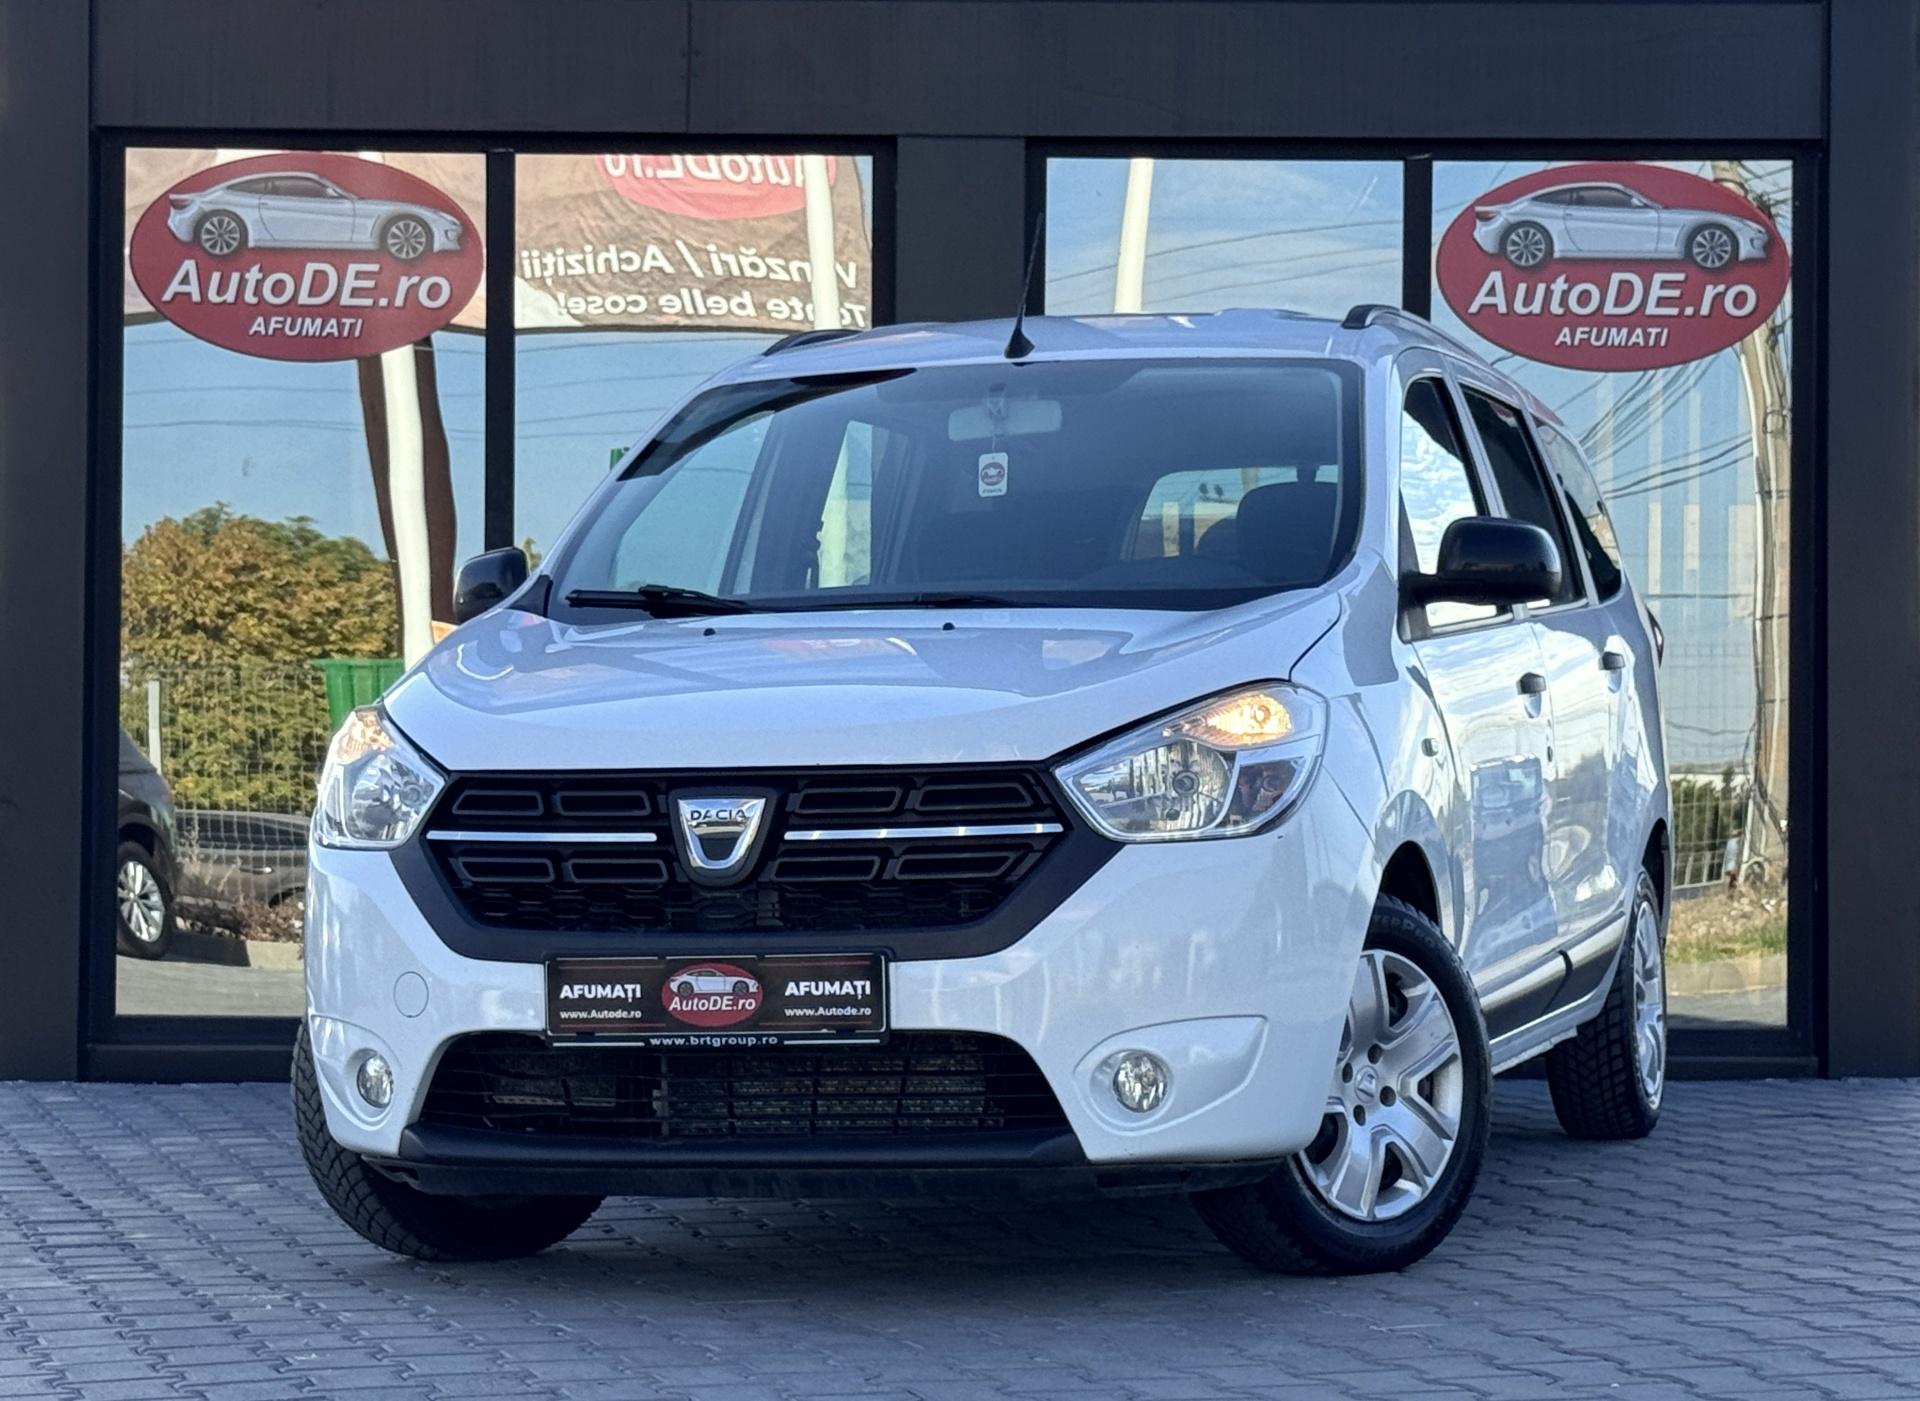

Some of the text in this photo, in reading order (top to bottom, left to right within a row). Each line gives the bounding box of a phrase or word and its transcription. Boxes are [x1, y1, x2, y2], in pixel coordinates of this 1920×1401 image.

[161, 259, 452, 310] AutoDE.ro
[1467, 270, 1758, 317] AutoDE.ro
[248, 316, 363, 338] AFUMATI
[1554, 326, 1669, 347] AFUMATI
[690, 809, 747, 821] DACIA
[668, 995, 756, 1012] AutoDE.ro
[784, 1005, 873, 1017] www.Autode.ro
[559, 1008, 642, 1020] www.Autode.ro
[649, 1035, 779, 1047] www.brtgroup.ro
